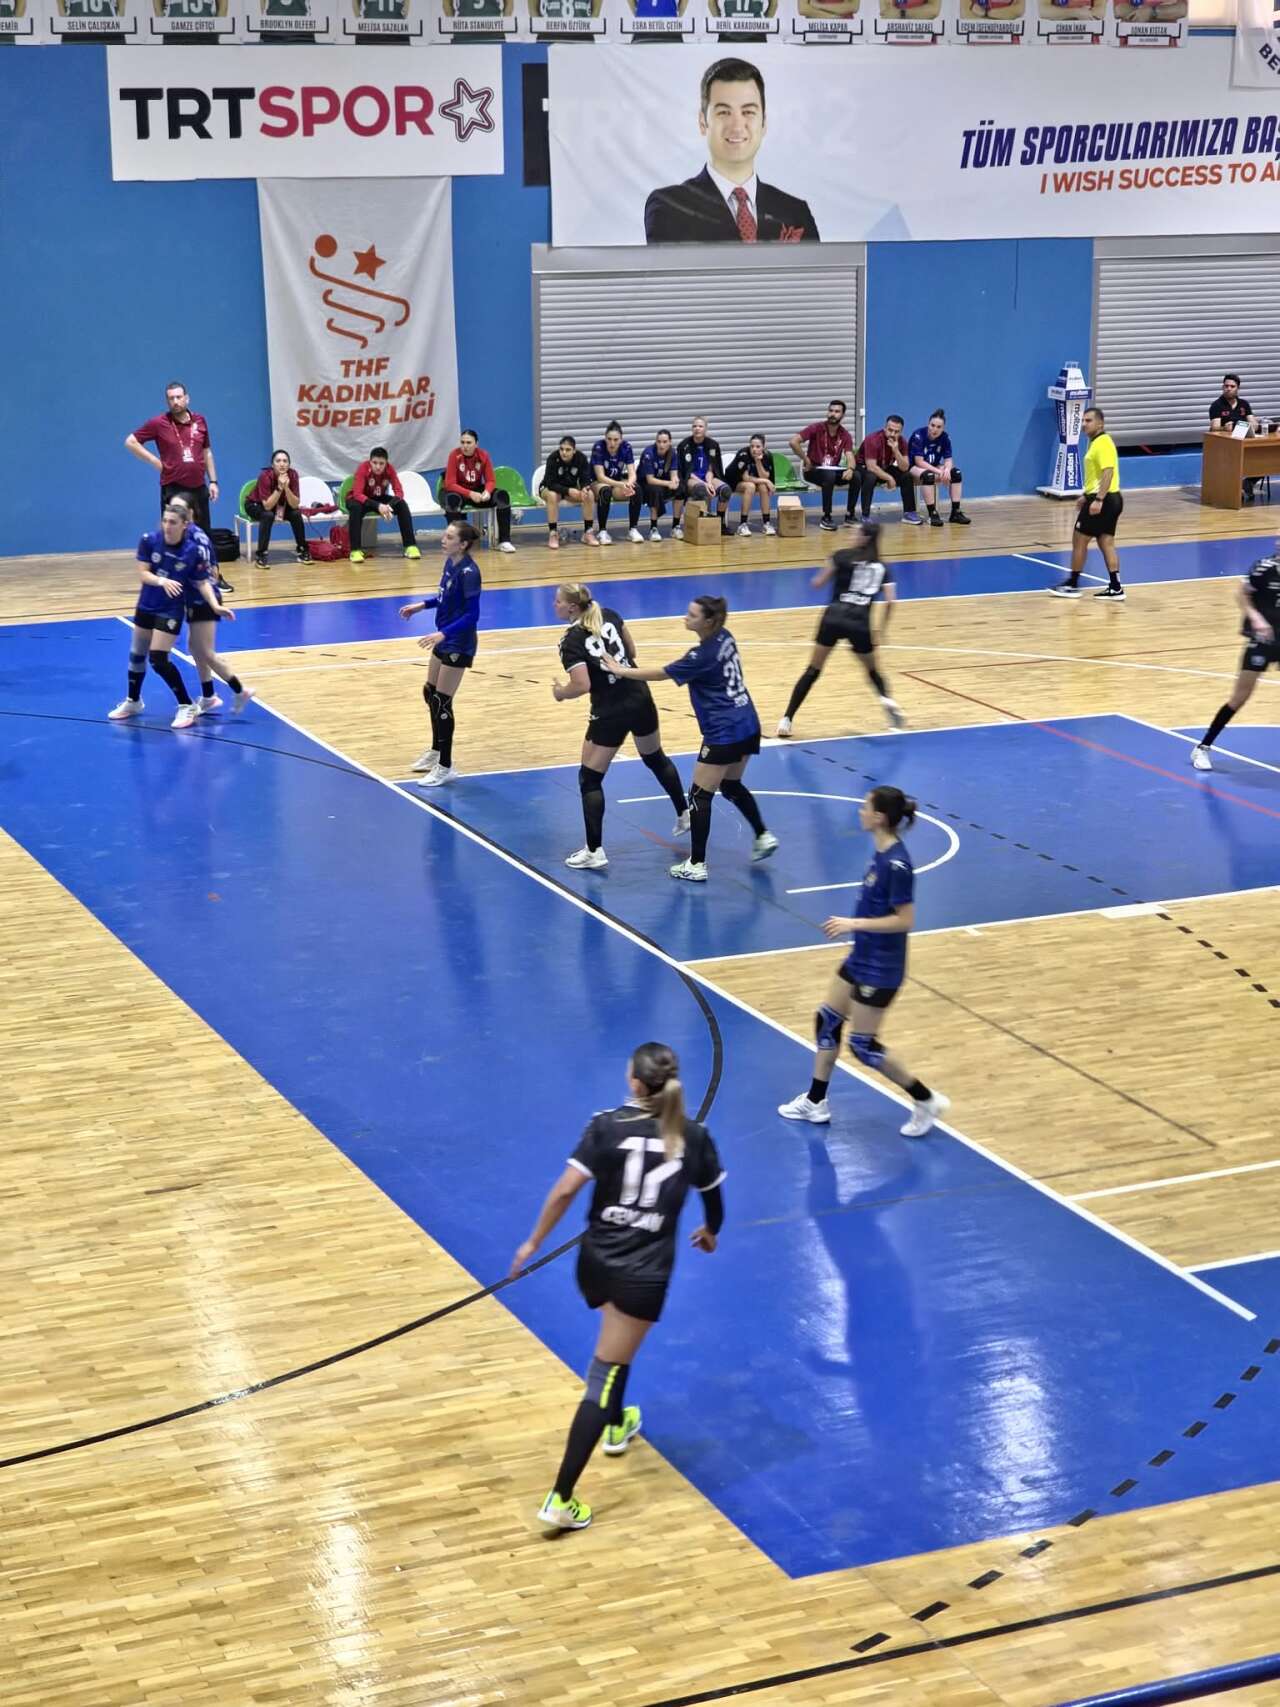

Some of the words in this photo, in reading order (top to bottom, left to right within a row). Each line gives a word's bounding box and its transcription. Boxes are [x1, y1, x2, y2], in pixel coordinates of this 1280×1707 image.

[0, 20, 18, 31] EMİR
[67, 20, 87, 30] SELİN
[171, 20, 193, 31] GAMZE
[1259, 43, 1280, 74] BE
[960, 119, 1016, 169] TÜM
[1020, 116, 1239, 166] SPORCULARIMIZA
[1039, 173, 1048, 194] I
[1053, 169, 1115, 193] WISH
[1118, 164, 1223, 191] SUCCESS
[1228, 161, 1257, 183] TO
[340, 357, 390, 378] THF
[297, 376, 431, 404] KADINLAR
[296, 404, 382, 428] SÜPER
[389, 392, 436, 424] LİGİ
[616, 1136, 685, 1209] 17
